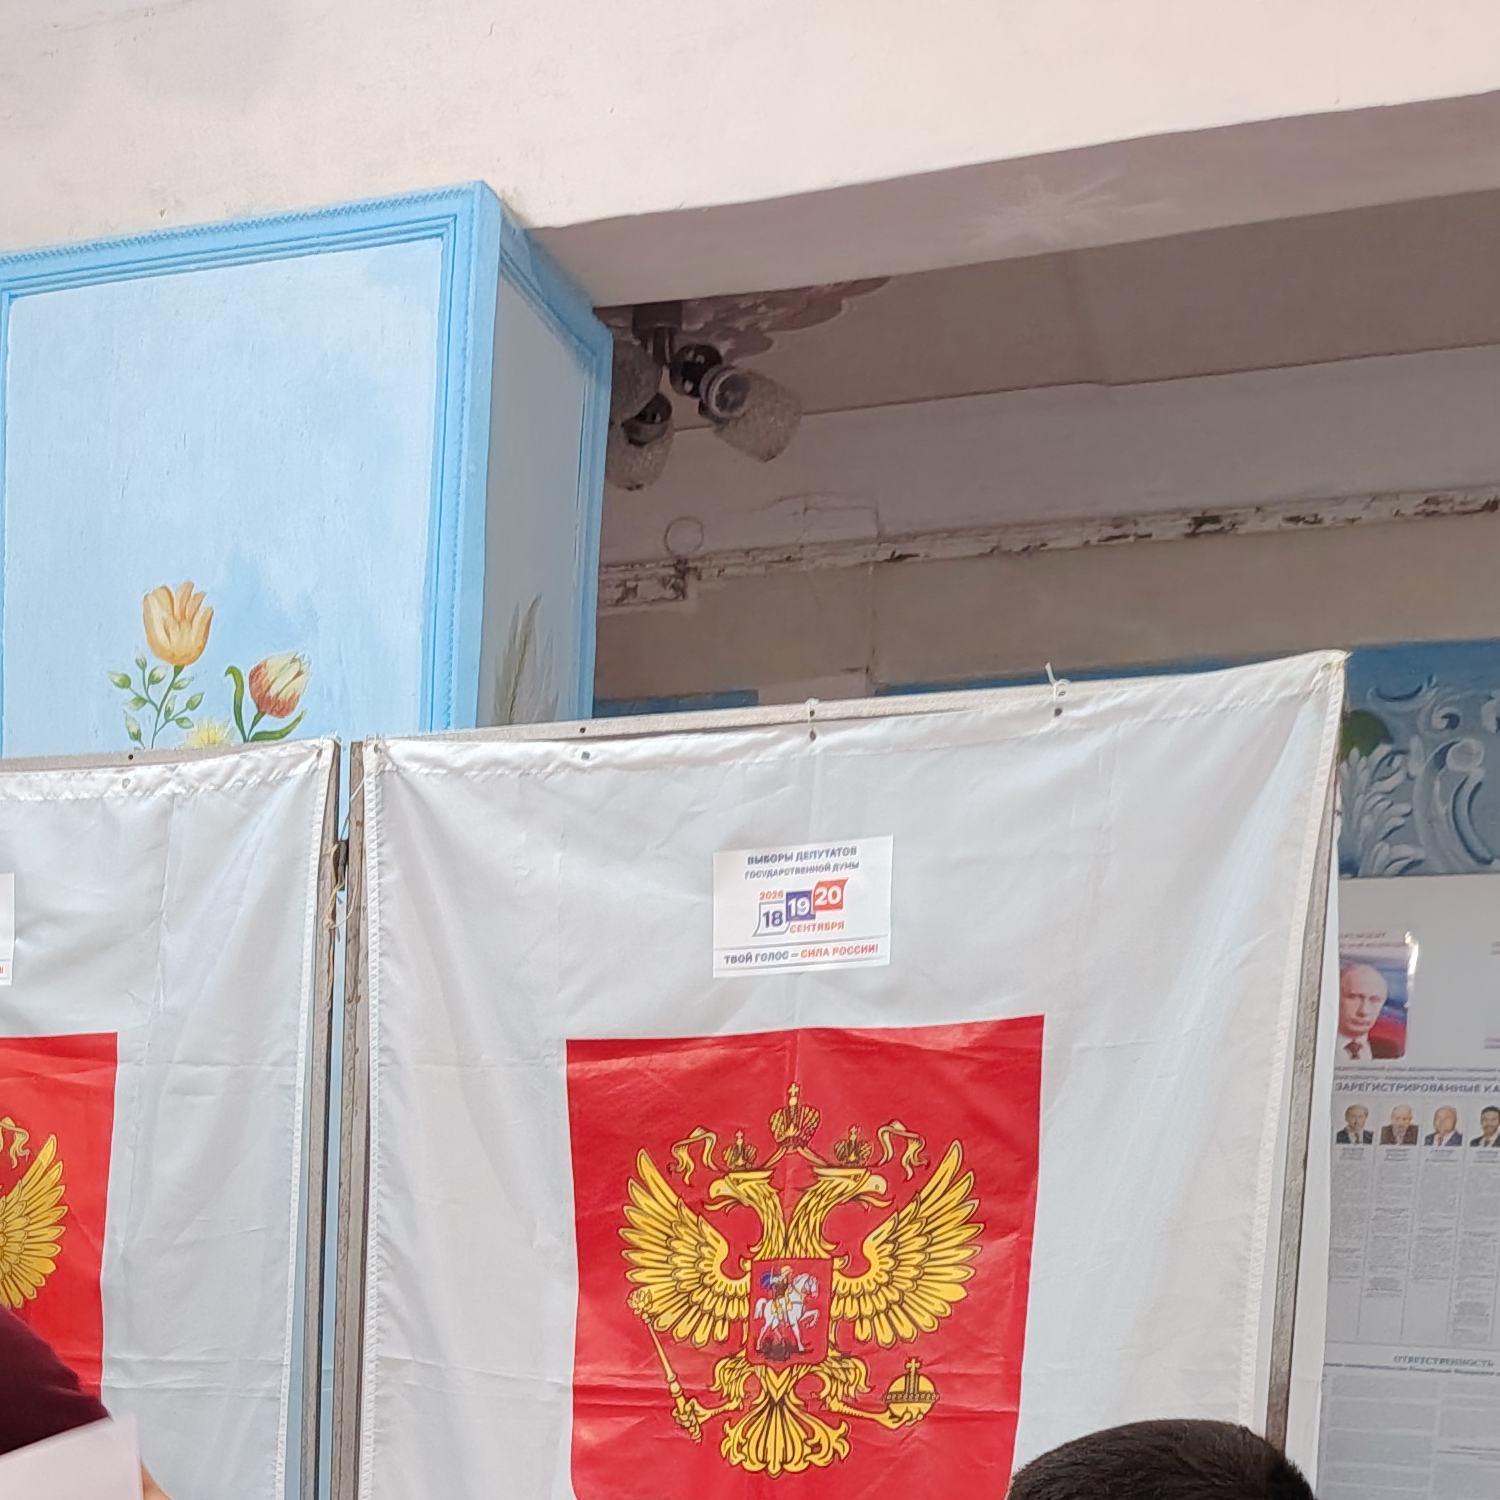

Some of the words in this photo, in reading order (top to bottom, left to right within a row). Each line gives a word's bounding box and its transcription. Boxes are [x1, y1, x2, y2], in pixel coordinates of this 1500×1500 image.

[747, 852, 793, 865] ВЫБОРЫ
[795, 846, 857, 861] ДЕПУТАТОВ
[744, 862, 831, 880] ГОСУДАРСТВЕННОЙ
[832, 861, 860, 872] ДУМЫ
[762, 910, 784, 928] 18
[787, 897, 811, 917] 19
[814, 885, 842, 906] 20
[789, 921, 845, 934] СЕНТЯБРЯ
[724, 952, 753, 964] ТВОЙ
[754, 951, 790, 963] ГОЛОС
[800, 947, 830, 959] СИЛА
[832, 943, 879, 957] РОССИИ!
